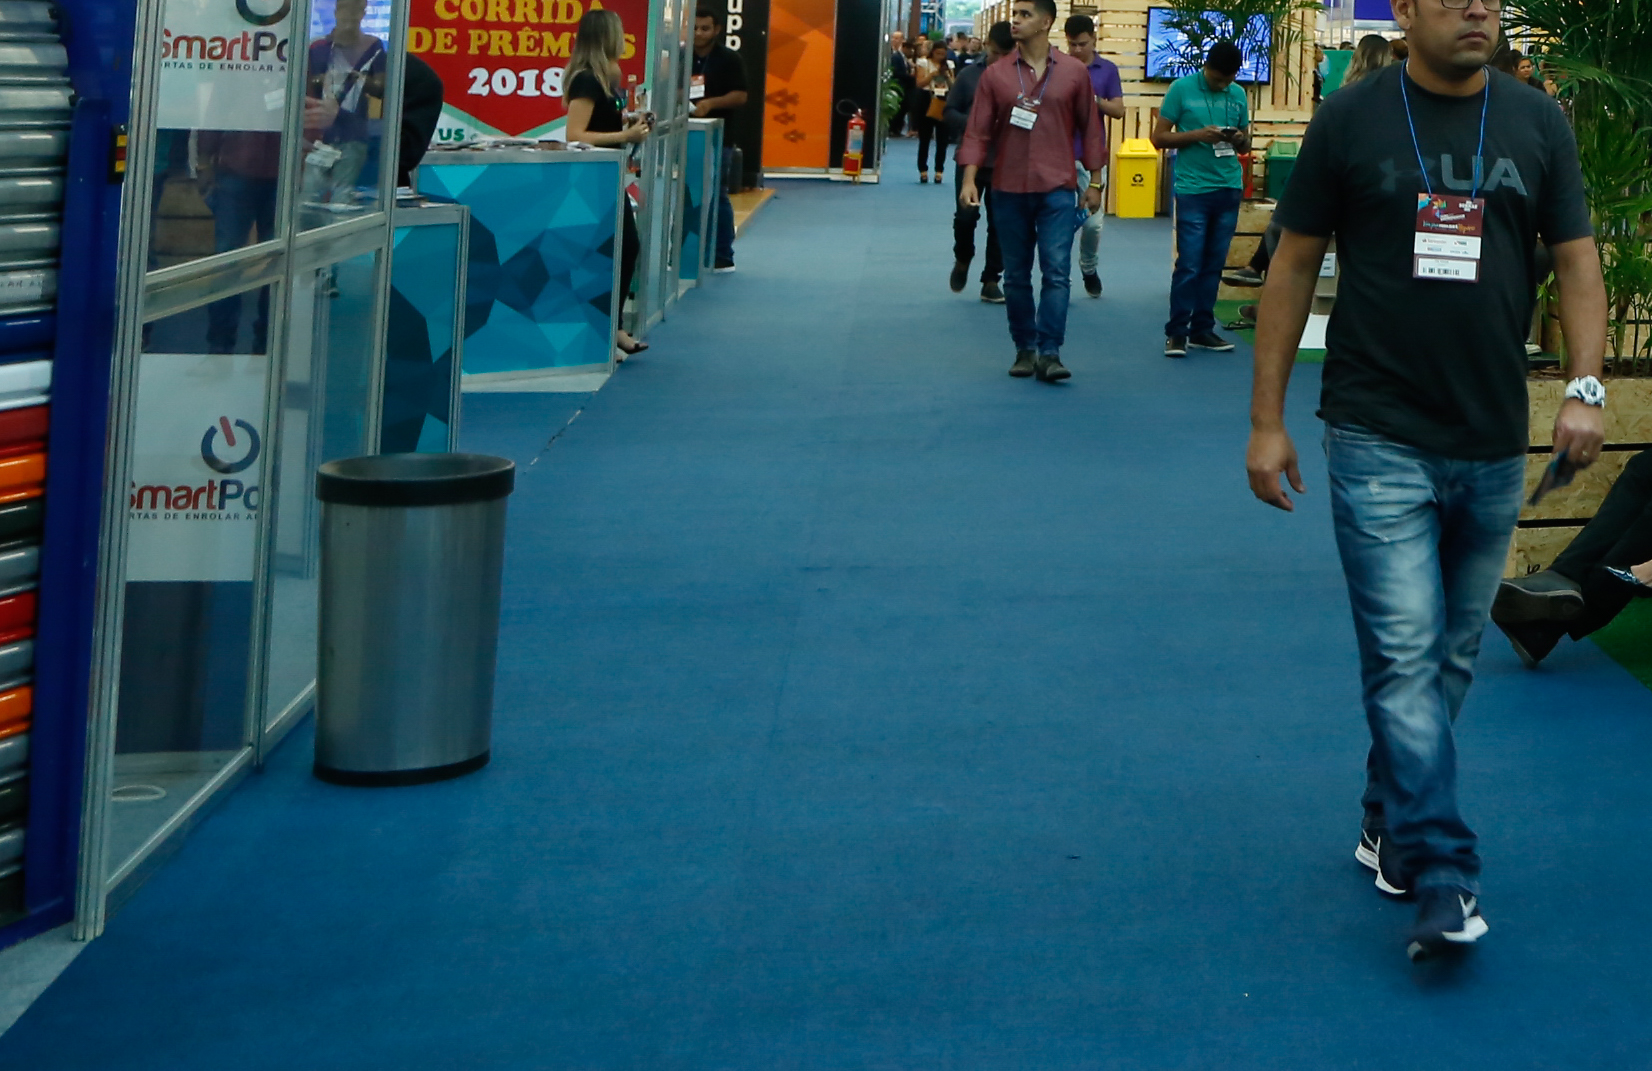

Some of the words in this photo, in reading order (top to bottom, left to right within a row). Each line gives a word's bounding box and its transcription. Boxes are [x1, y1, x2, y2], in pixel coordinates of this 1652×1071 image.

[407, 27, 458, 54] DE
[467, 27, 636, 59] PRÊMS
[200, 62, 214, 70] DE
[219, 63, 274, 72] ENROLAR
[467, 67, 564, 98] 2018
[1441, 153, 1528, 196] UA
[164, 512, 179, 520] DE
[185, 512, 240, 521] ENROLAR
